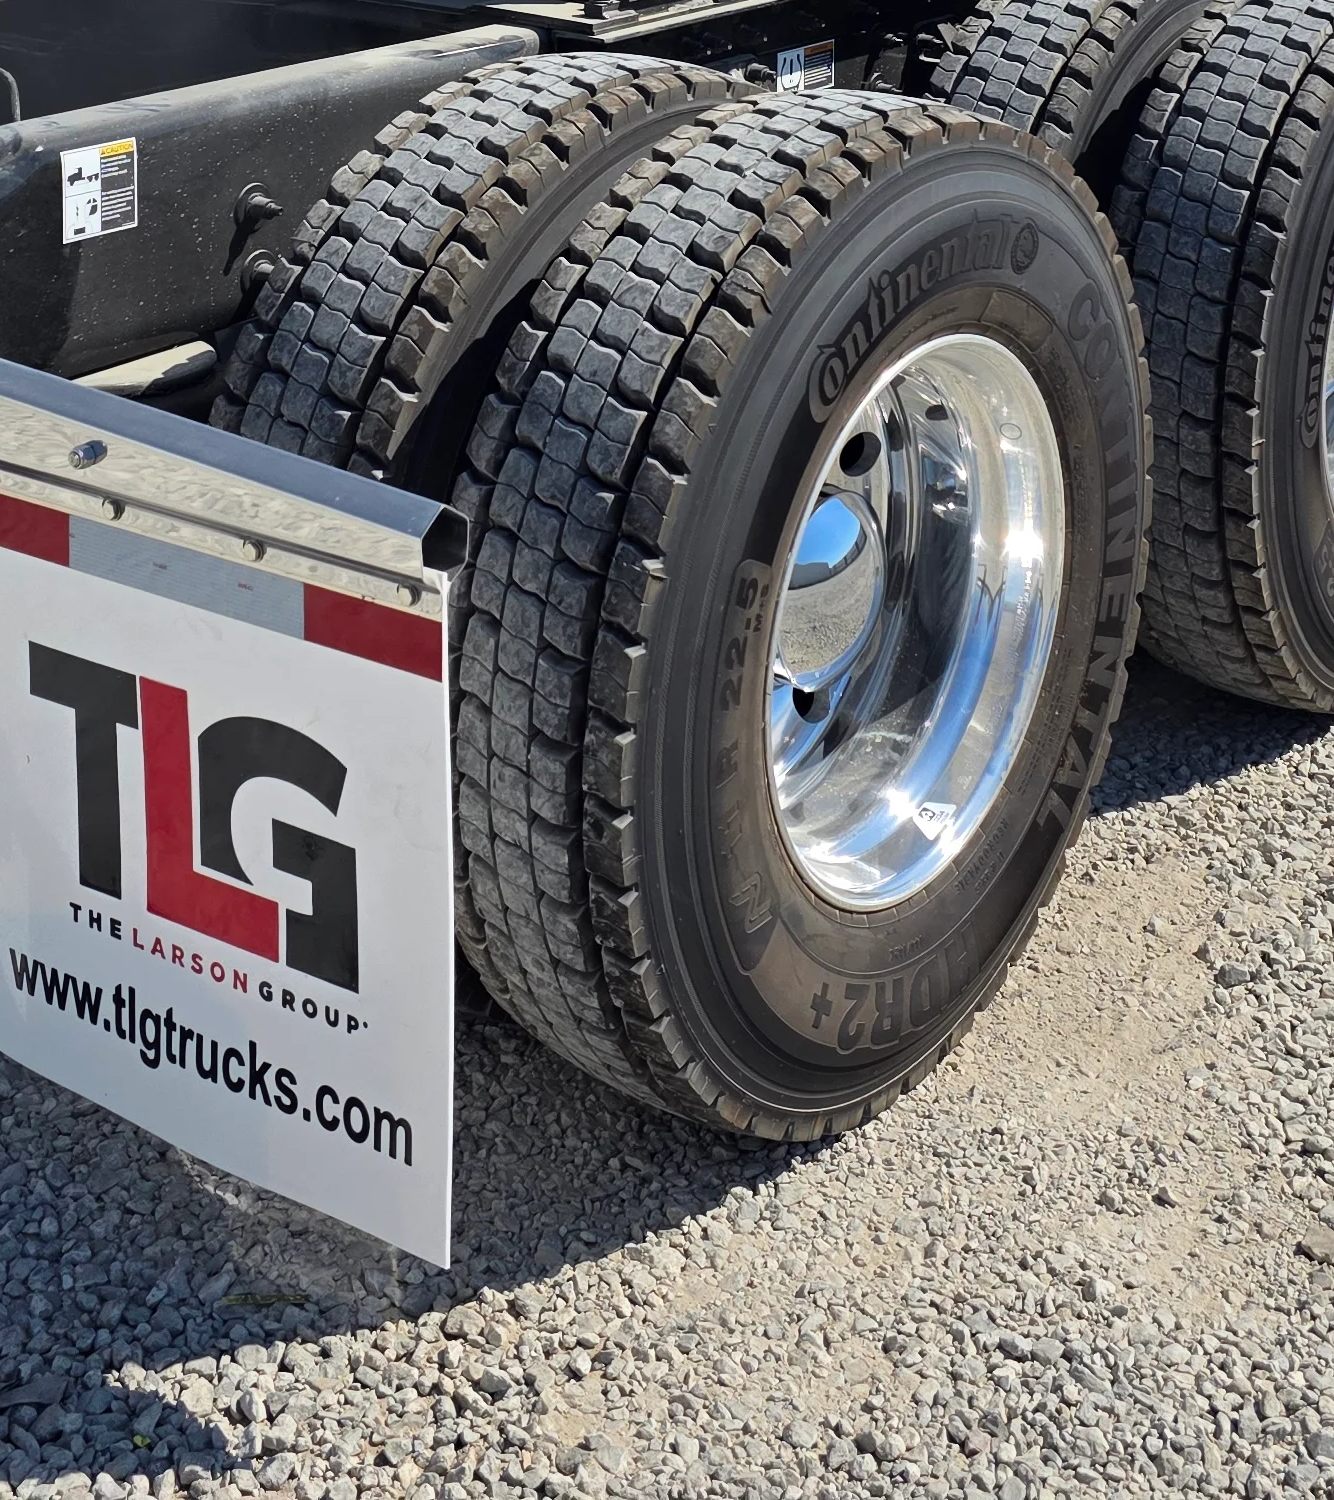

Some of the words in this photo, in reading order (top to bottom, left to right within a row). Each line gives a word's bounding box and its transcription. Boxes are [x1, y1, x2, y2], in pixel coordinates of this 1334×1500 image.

[809, 208, 1012, 423] Continental
[720, 576, 759, 712] 22.5
[751, 583, 771, 634] M+S
[1035, 282, 1139, 833] CONTINENTAL
[28, 640, 360, 994] TLG
[69, 902, 122, 940] THE
[132, 928, 249, 994] LARSON
[258, 980, 362, 1035] GROUP
[810, 920, 983, 1055] HDR2+
[9, 948, 413, 1167] www.tlgtrucks.com
